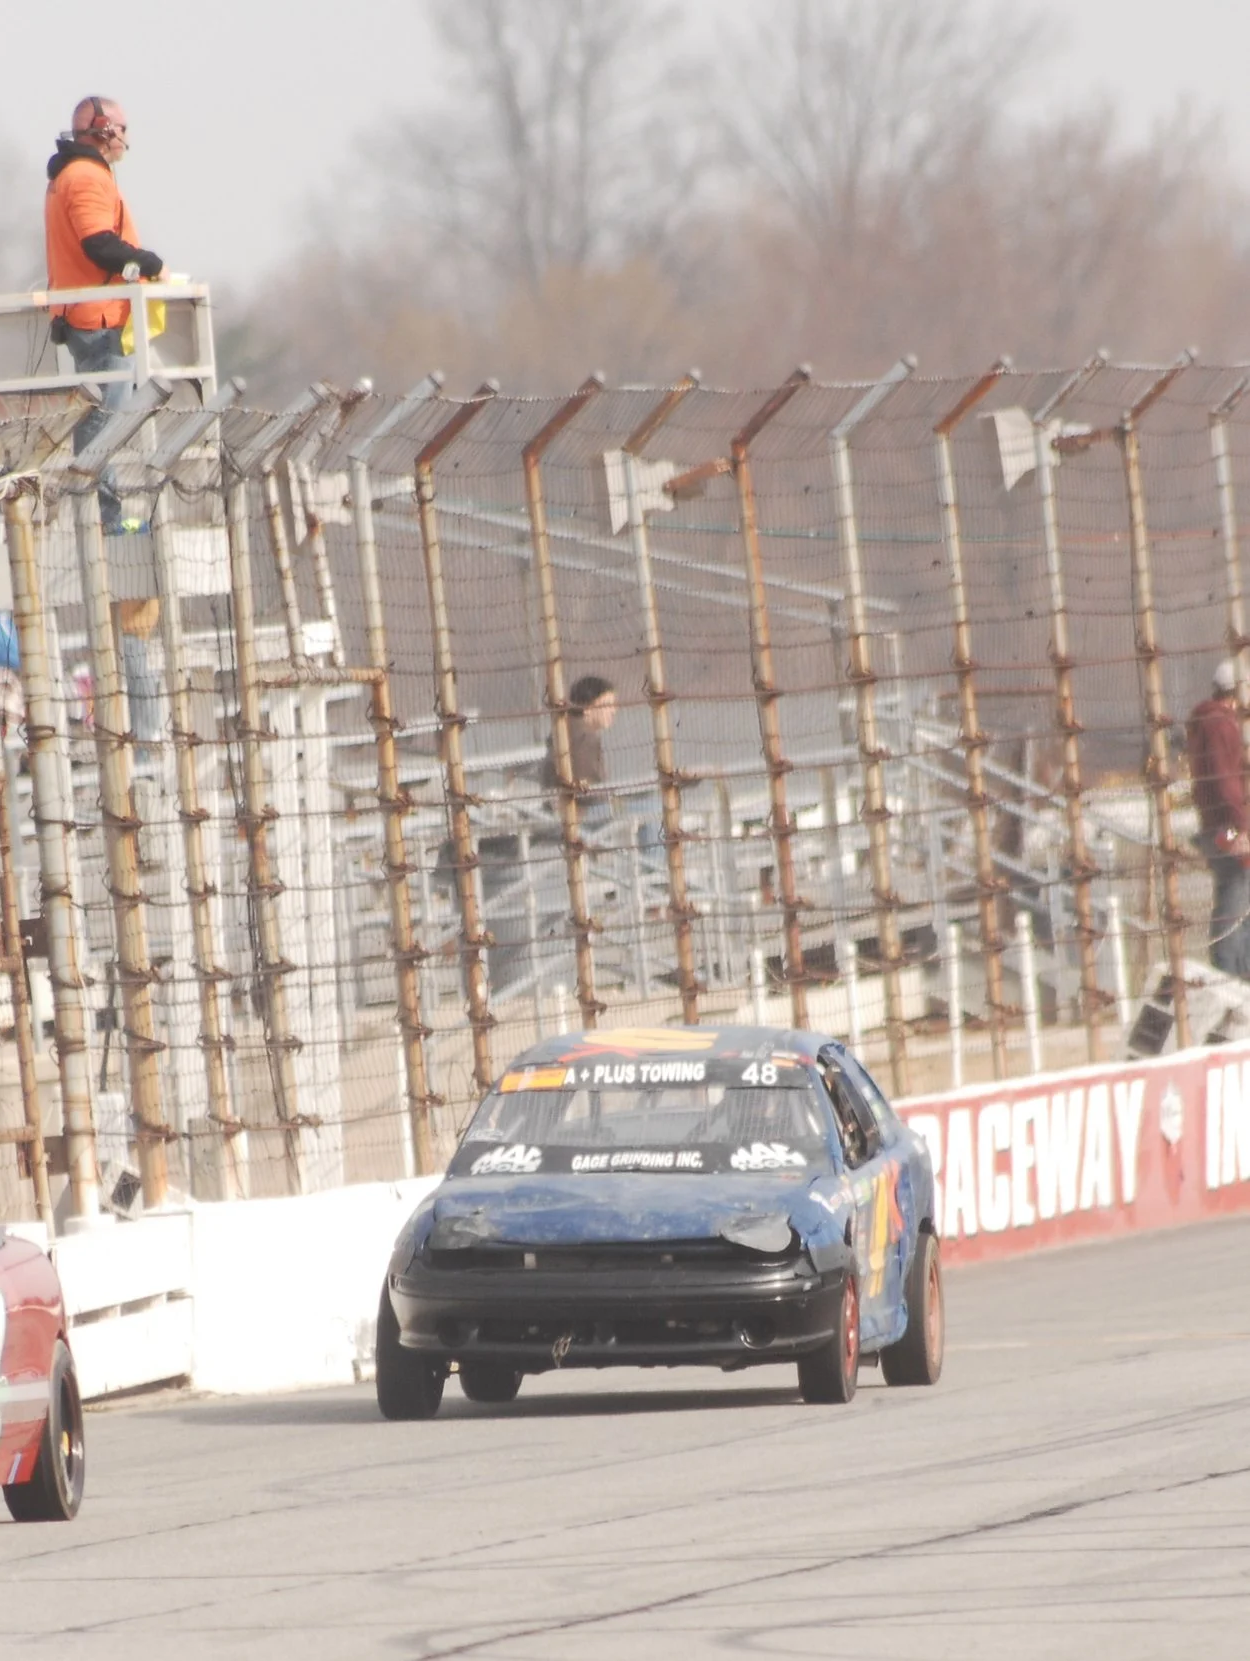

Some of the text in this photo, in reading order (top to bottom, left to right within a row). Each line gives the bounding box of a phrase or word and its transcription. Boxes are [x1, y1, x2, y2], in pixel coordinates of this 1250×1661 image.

[594, 1063, 635, 1084] PLUS
[640, 1061, 705, 1083] TOWING
[741, 1061, 777, 1085] 48
[571, 1151, 703, 1170] GAGE GRINDING INC.
[907, 1079, 1146, 1240] RACEWAY
